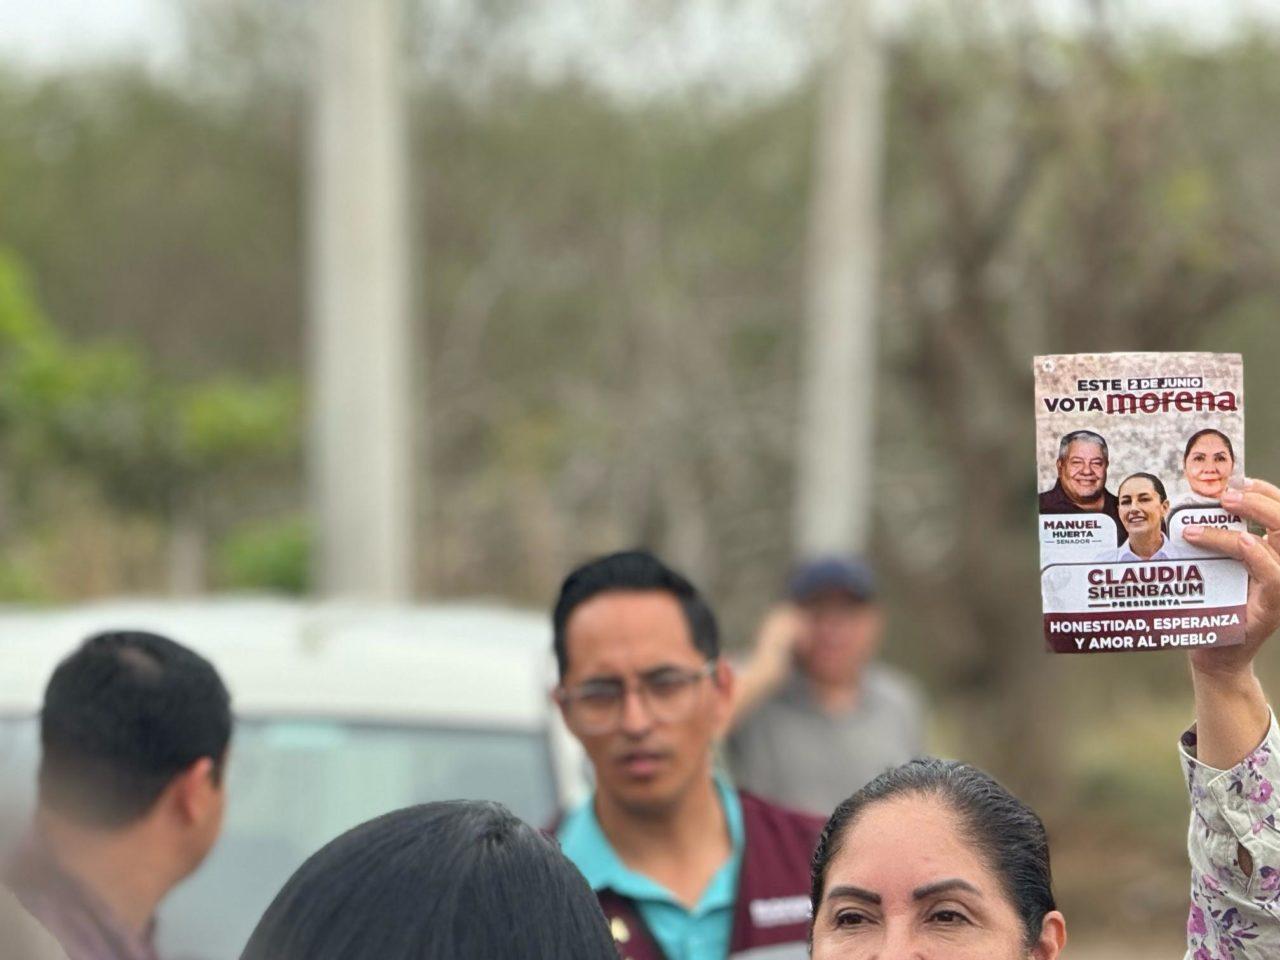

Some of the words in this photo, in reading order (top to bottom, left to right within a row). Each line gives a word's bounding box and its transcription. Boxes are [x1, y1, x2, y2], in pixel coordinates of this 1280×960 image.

[1077, 379, 1122, 391] ESTE
[1130, 379, 1139, 389] 2
[1141, 379, 1159, 389] DE
[1161, 378, 1201, 388] JUNIO
[1044, 397, 1103, 413] VOTA
[1106, 390, 1238, 415] morena
[1044, 520, 1101, 530] MANUEL
[1181, 514, 1242, 525] CLAUDIA
[1052, 530, 1094, 538] HUERTA
[1088, 566, 1203, 584] CLAUDIA
[1088, 584, 1204, 599] SHEINBAUM
[1112, 599, 1181, 608] PRESIDENTA
[1050, 618, 1150, 634] HONESTIDAD,
[1153, 614, 1240, 630] ESPERANZA
[1075, 638, 1084, 649] Y
[1086, 636, 1134, 649] AMOR
[1138, 635, 1157, 647] AL
[1160, 632, 1217, 646] PUEBLO
